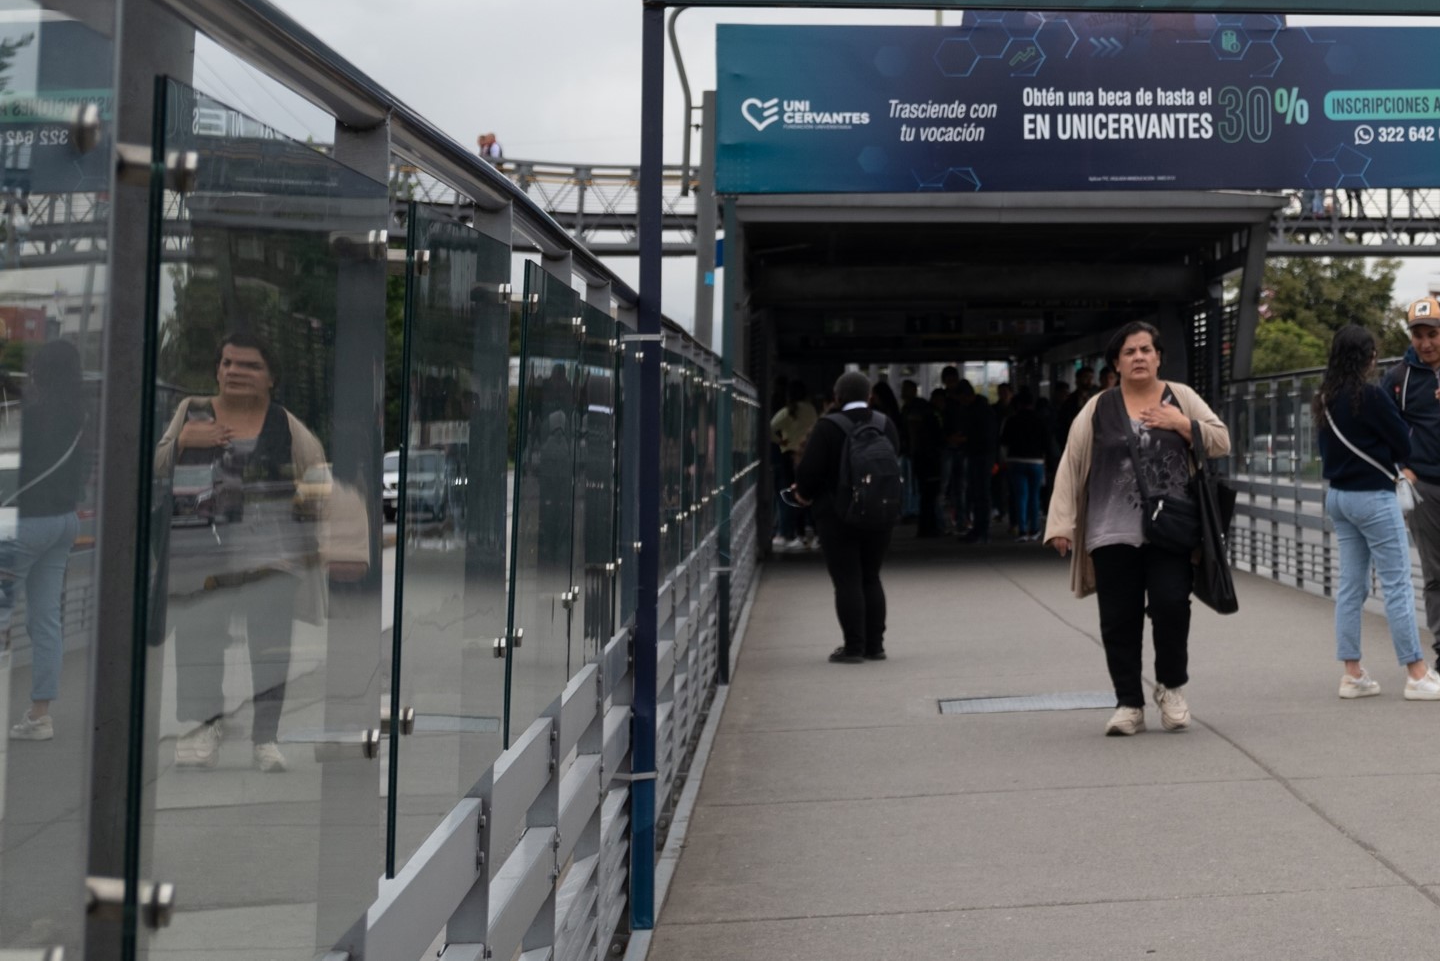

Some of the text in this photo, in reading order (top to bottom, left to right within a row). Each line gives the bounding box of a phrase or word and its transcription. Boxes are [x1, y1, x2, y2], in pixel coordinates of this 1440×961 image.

[1023, 87, 1212, 106] Obtén una beca de hasta el
[784, 100, 810, 113] UNI
[889, 100, 998, 119] Trasciende con
[1332, 97, 1429, 114] INSCRIPCIONES
[784, 112, 870, 126] CERVANTES
[1024, 113, 1213, 139] EN UNICERVANTES
[901, 123, 985, 141] tu vocación
[1379, 127, 1404, 142] 322
[1409, 126, 1437, 142] 642
